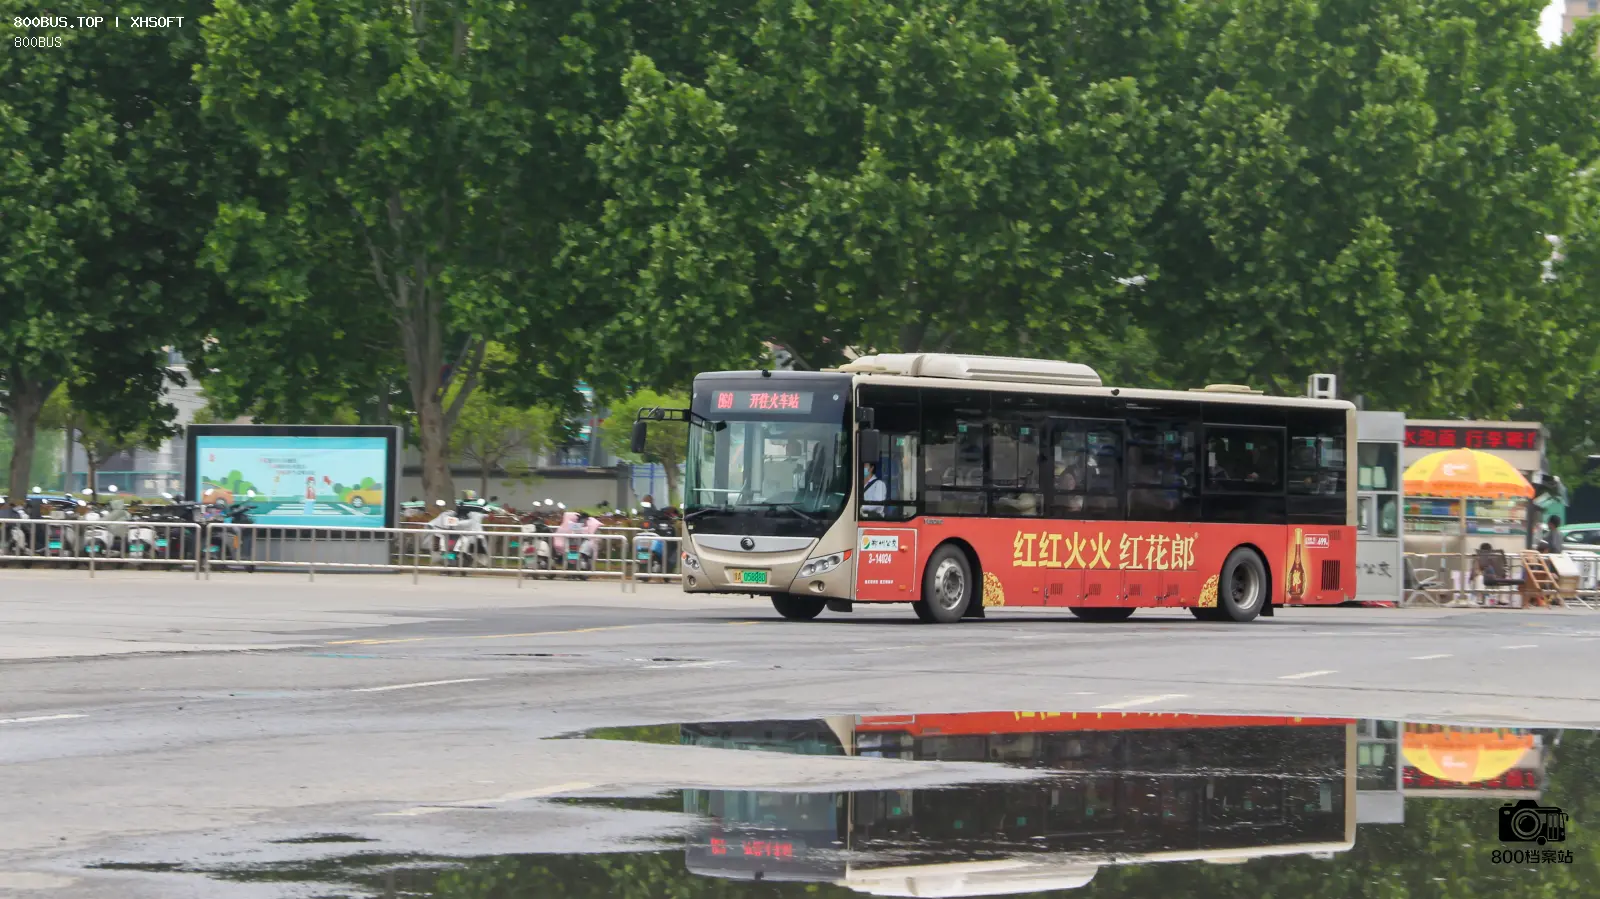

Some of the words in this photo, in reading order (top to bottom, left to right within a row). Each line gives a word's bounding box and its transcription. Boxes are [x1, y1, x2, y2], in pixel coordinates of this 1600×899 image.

[749, 391, 800, 410] 开往火车站
[1012, 530, 1112, 570] 红红火火
[1118, 532, 1196, 571] 红花郎
[1357, 560, 1393, 578] 公交
